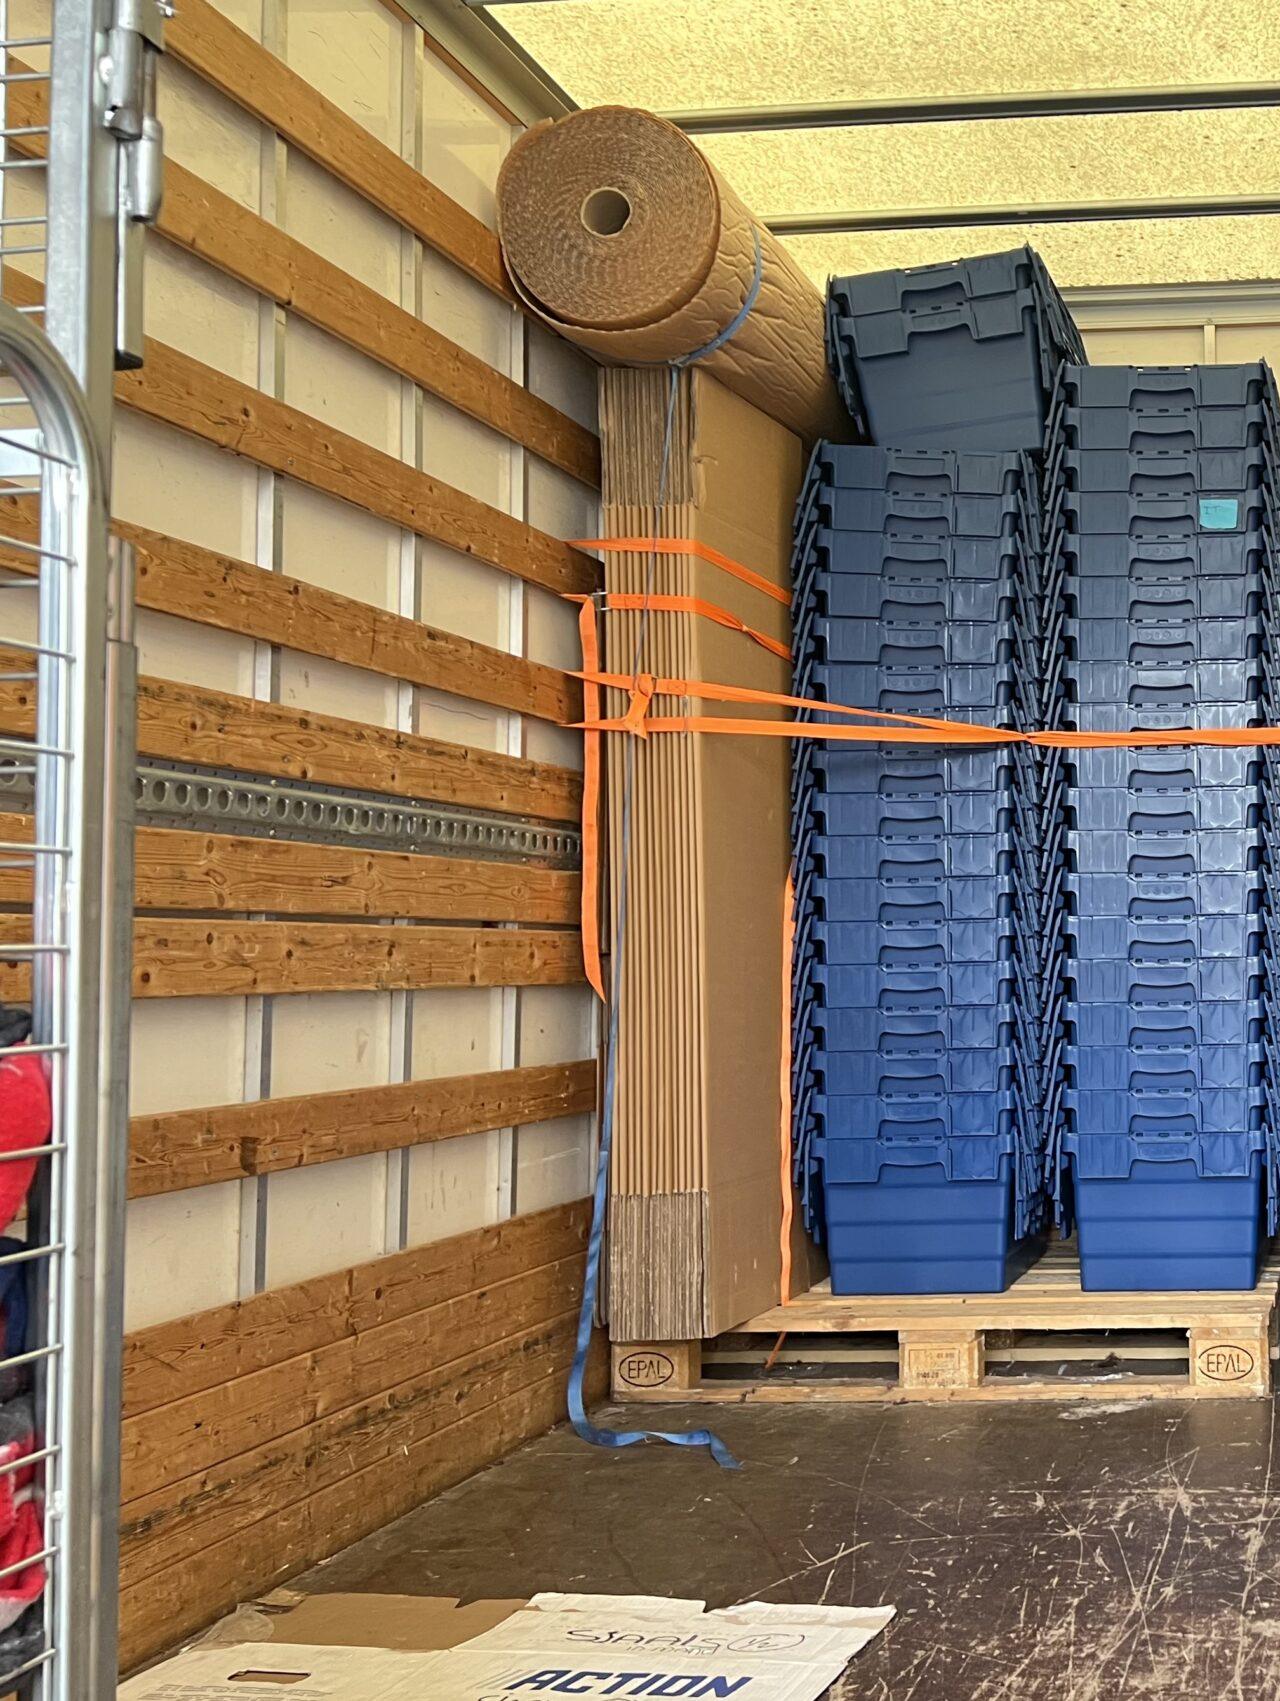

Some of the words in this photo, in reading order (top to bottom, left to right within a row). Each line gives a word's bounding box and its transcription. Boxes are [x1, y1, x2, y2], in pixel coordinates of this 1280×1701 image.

[627, 1360, 666, 1379] EPAL
[1206, 1353, 1246, 1373] EPAL
[502, 1669, 754, 1698] ACTION
